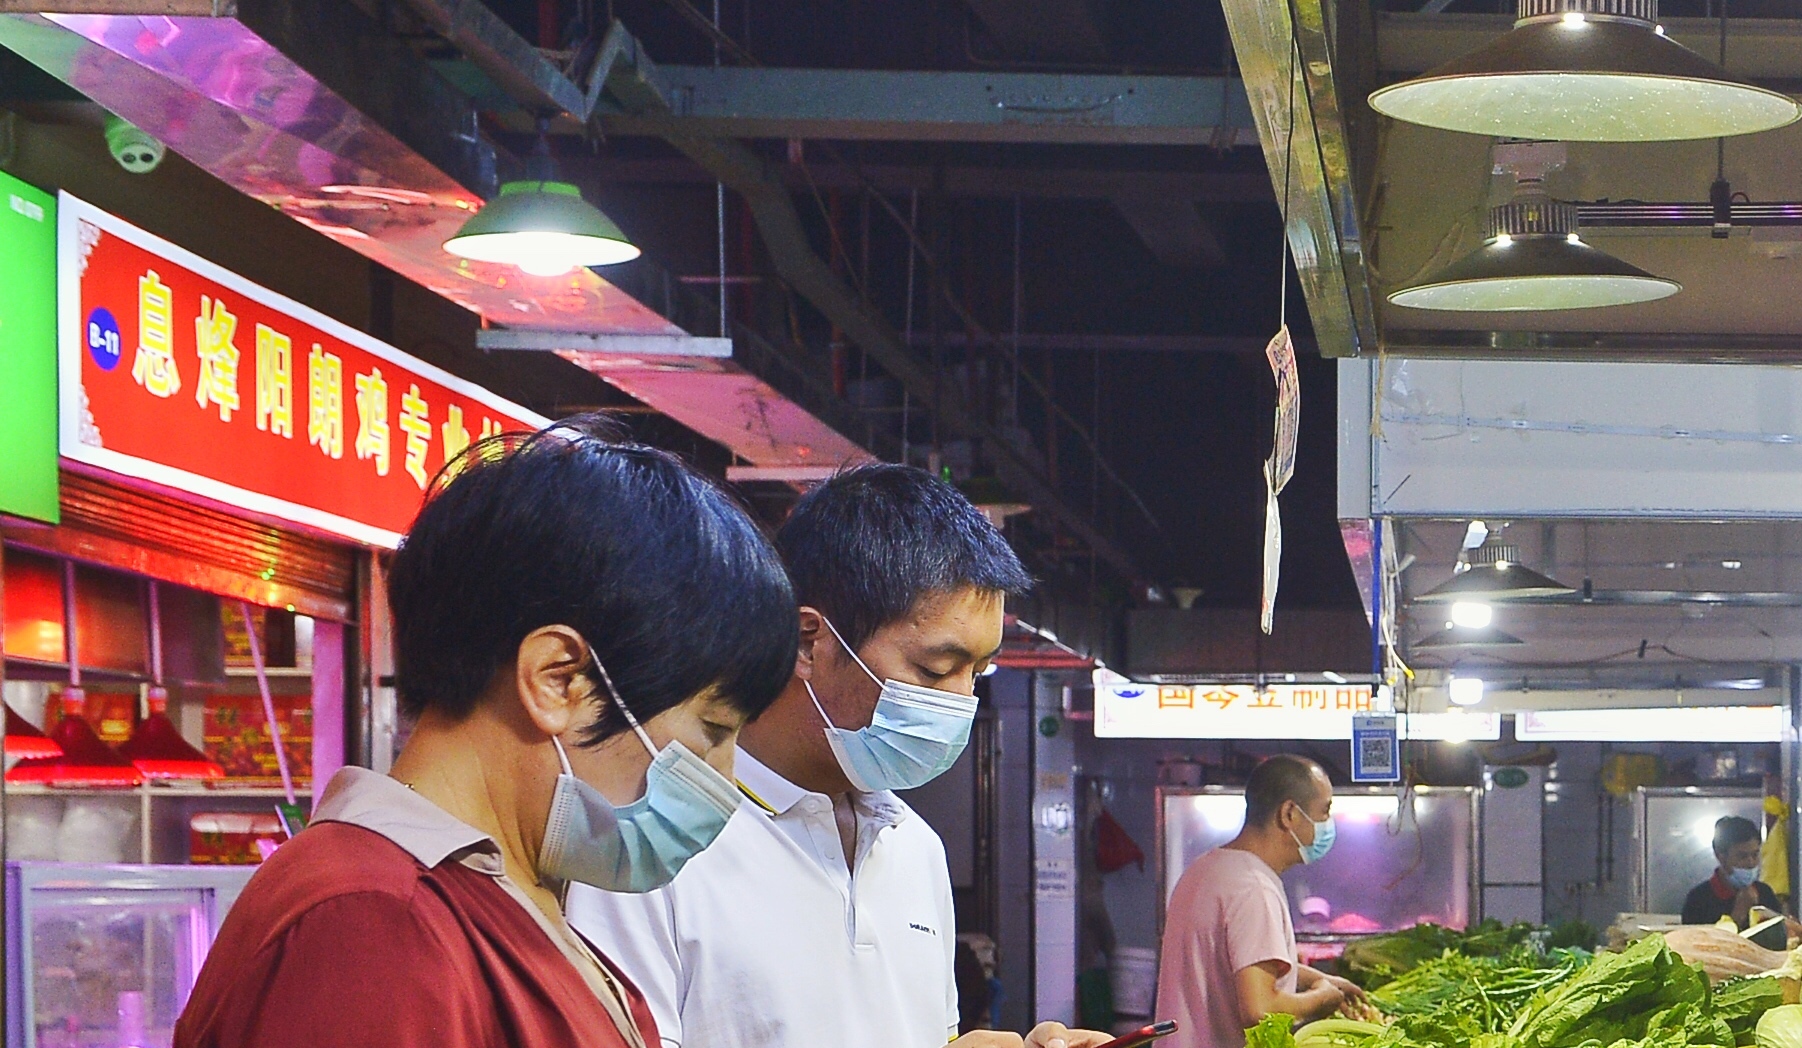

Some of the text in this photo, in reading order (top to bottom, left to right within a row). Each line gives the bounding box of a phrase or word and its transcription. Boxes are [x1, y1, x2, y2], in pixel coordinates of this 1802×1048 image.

[89, 322, 120, 356] B-11
[132, 269, 535, 490] 息烽阳朗鸡专业
